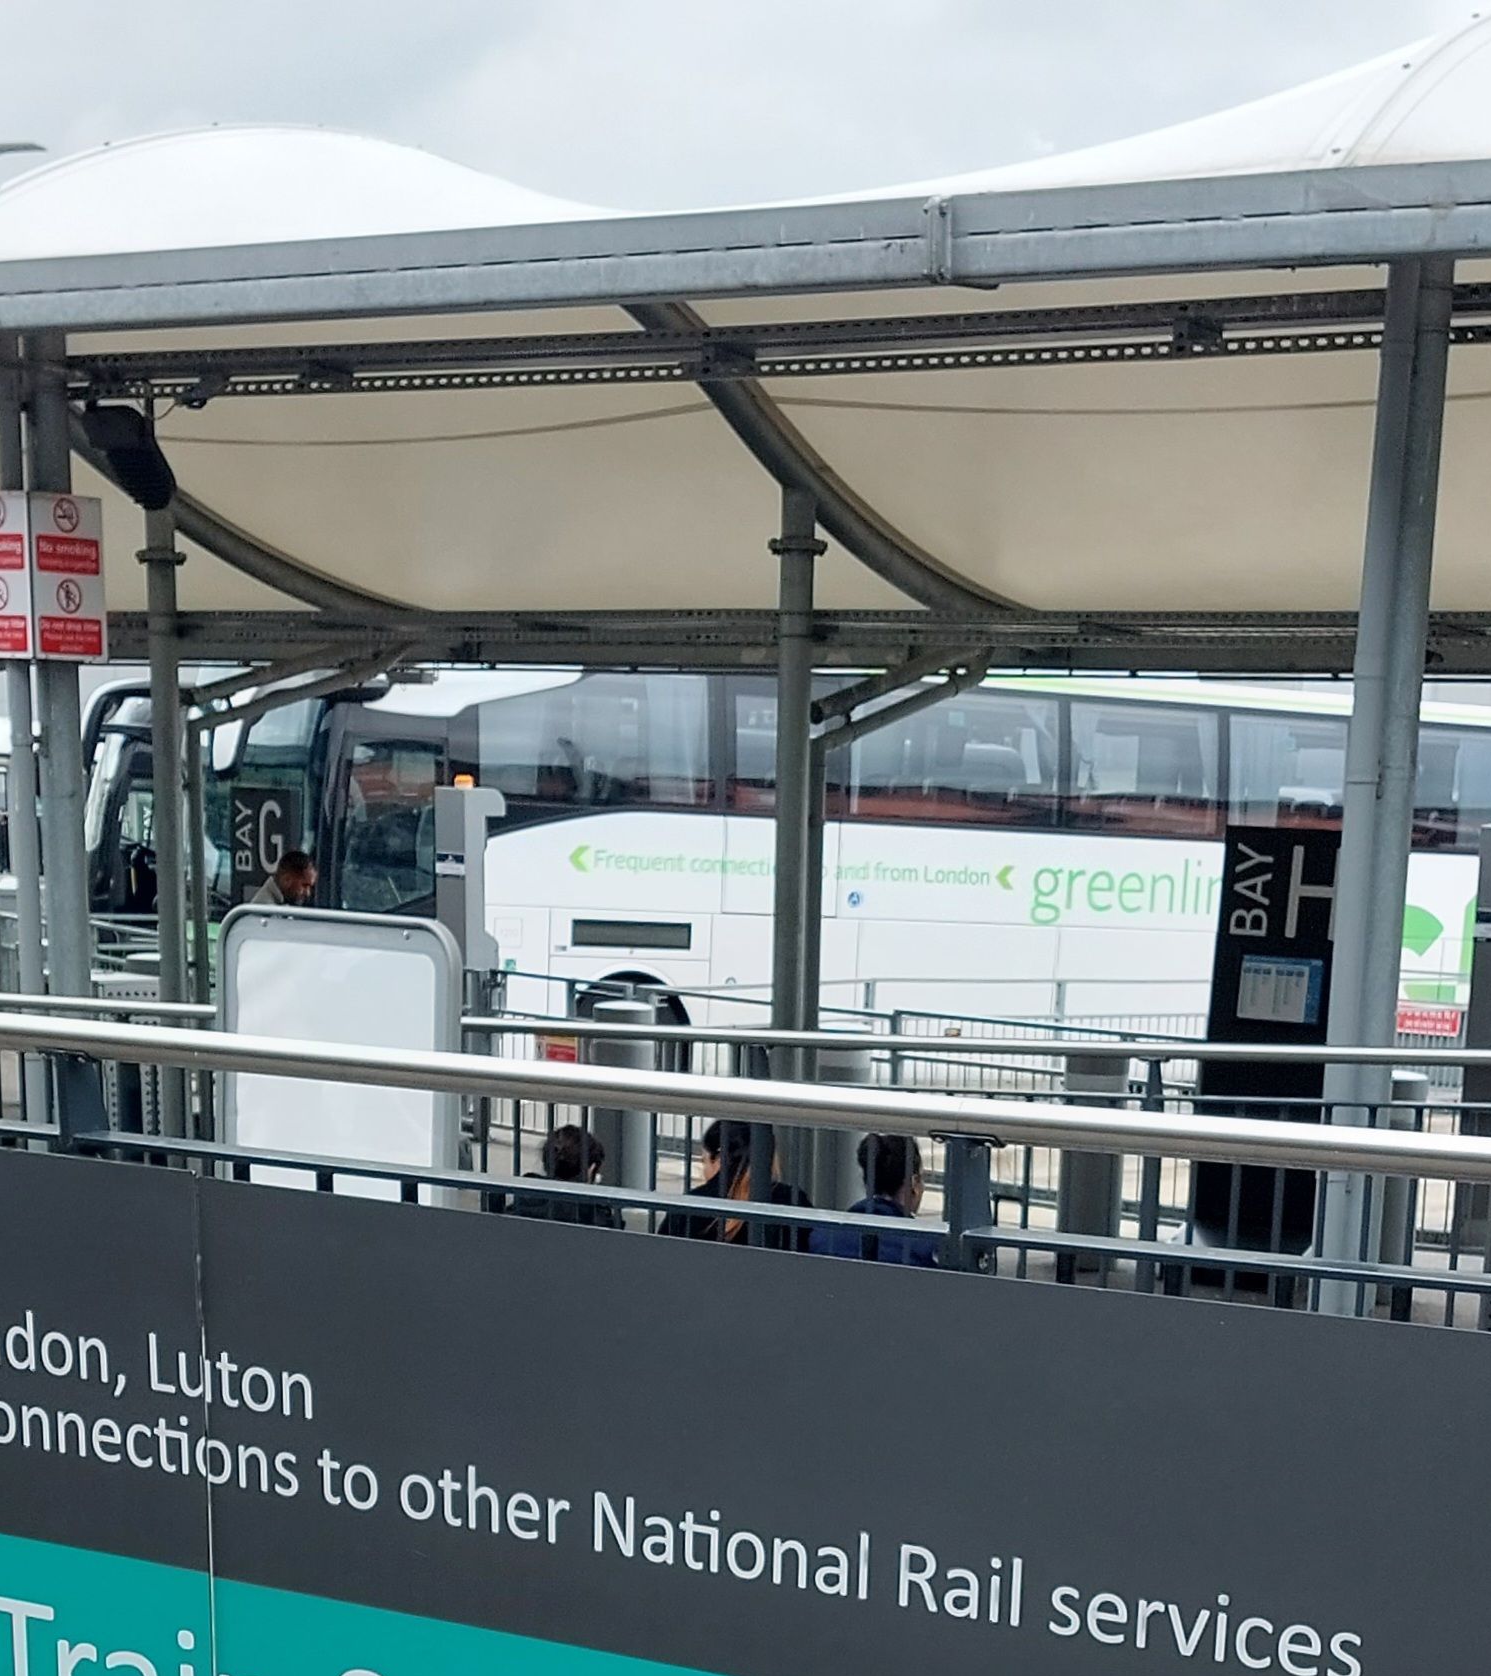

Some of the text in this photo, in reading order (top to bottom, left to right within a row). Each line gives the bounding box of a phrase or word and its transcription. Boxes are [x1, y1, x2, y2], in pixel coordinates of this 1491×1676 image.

[56, 543, 96, 560] smoking
[235, 800, 282, 874] BAY G
[593, 849, 777, 877] Frequent connecti
[874, 861, 918, 882] from
[924, 865, 990, 885] London
[1229, 842, 1339, 941] BAY H
[149, 1332, 313, 1420] Luton
[318, 1449, 377, 1511] to
[400, 1466, 569, 1551] other
[593, 1490, 869, 1600] National
[899, 1543, 1021, 1627] Rail
